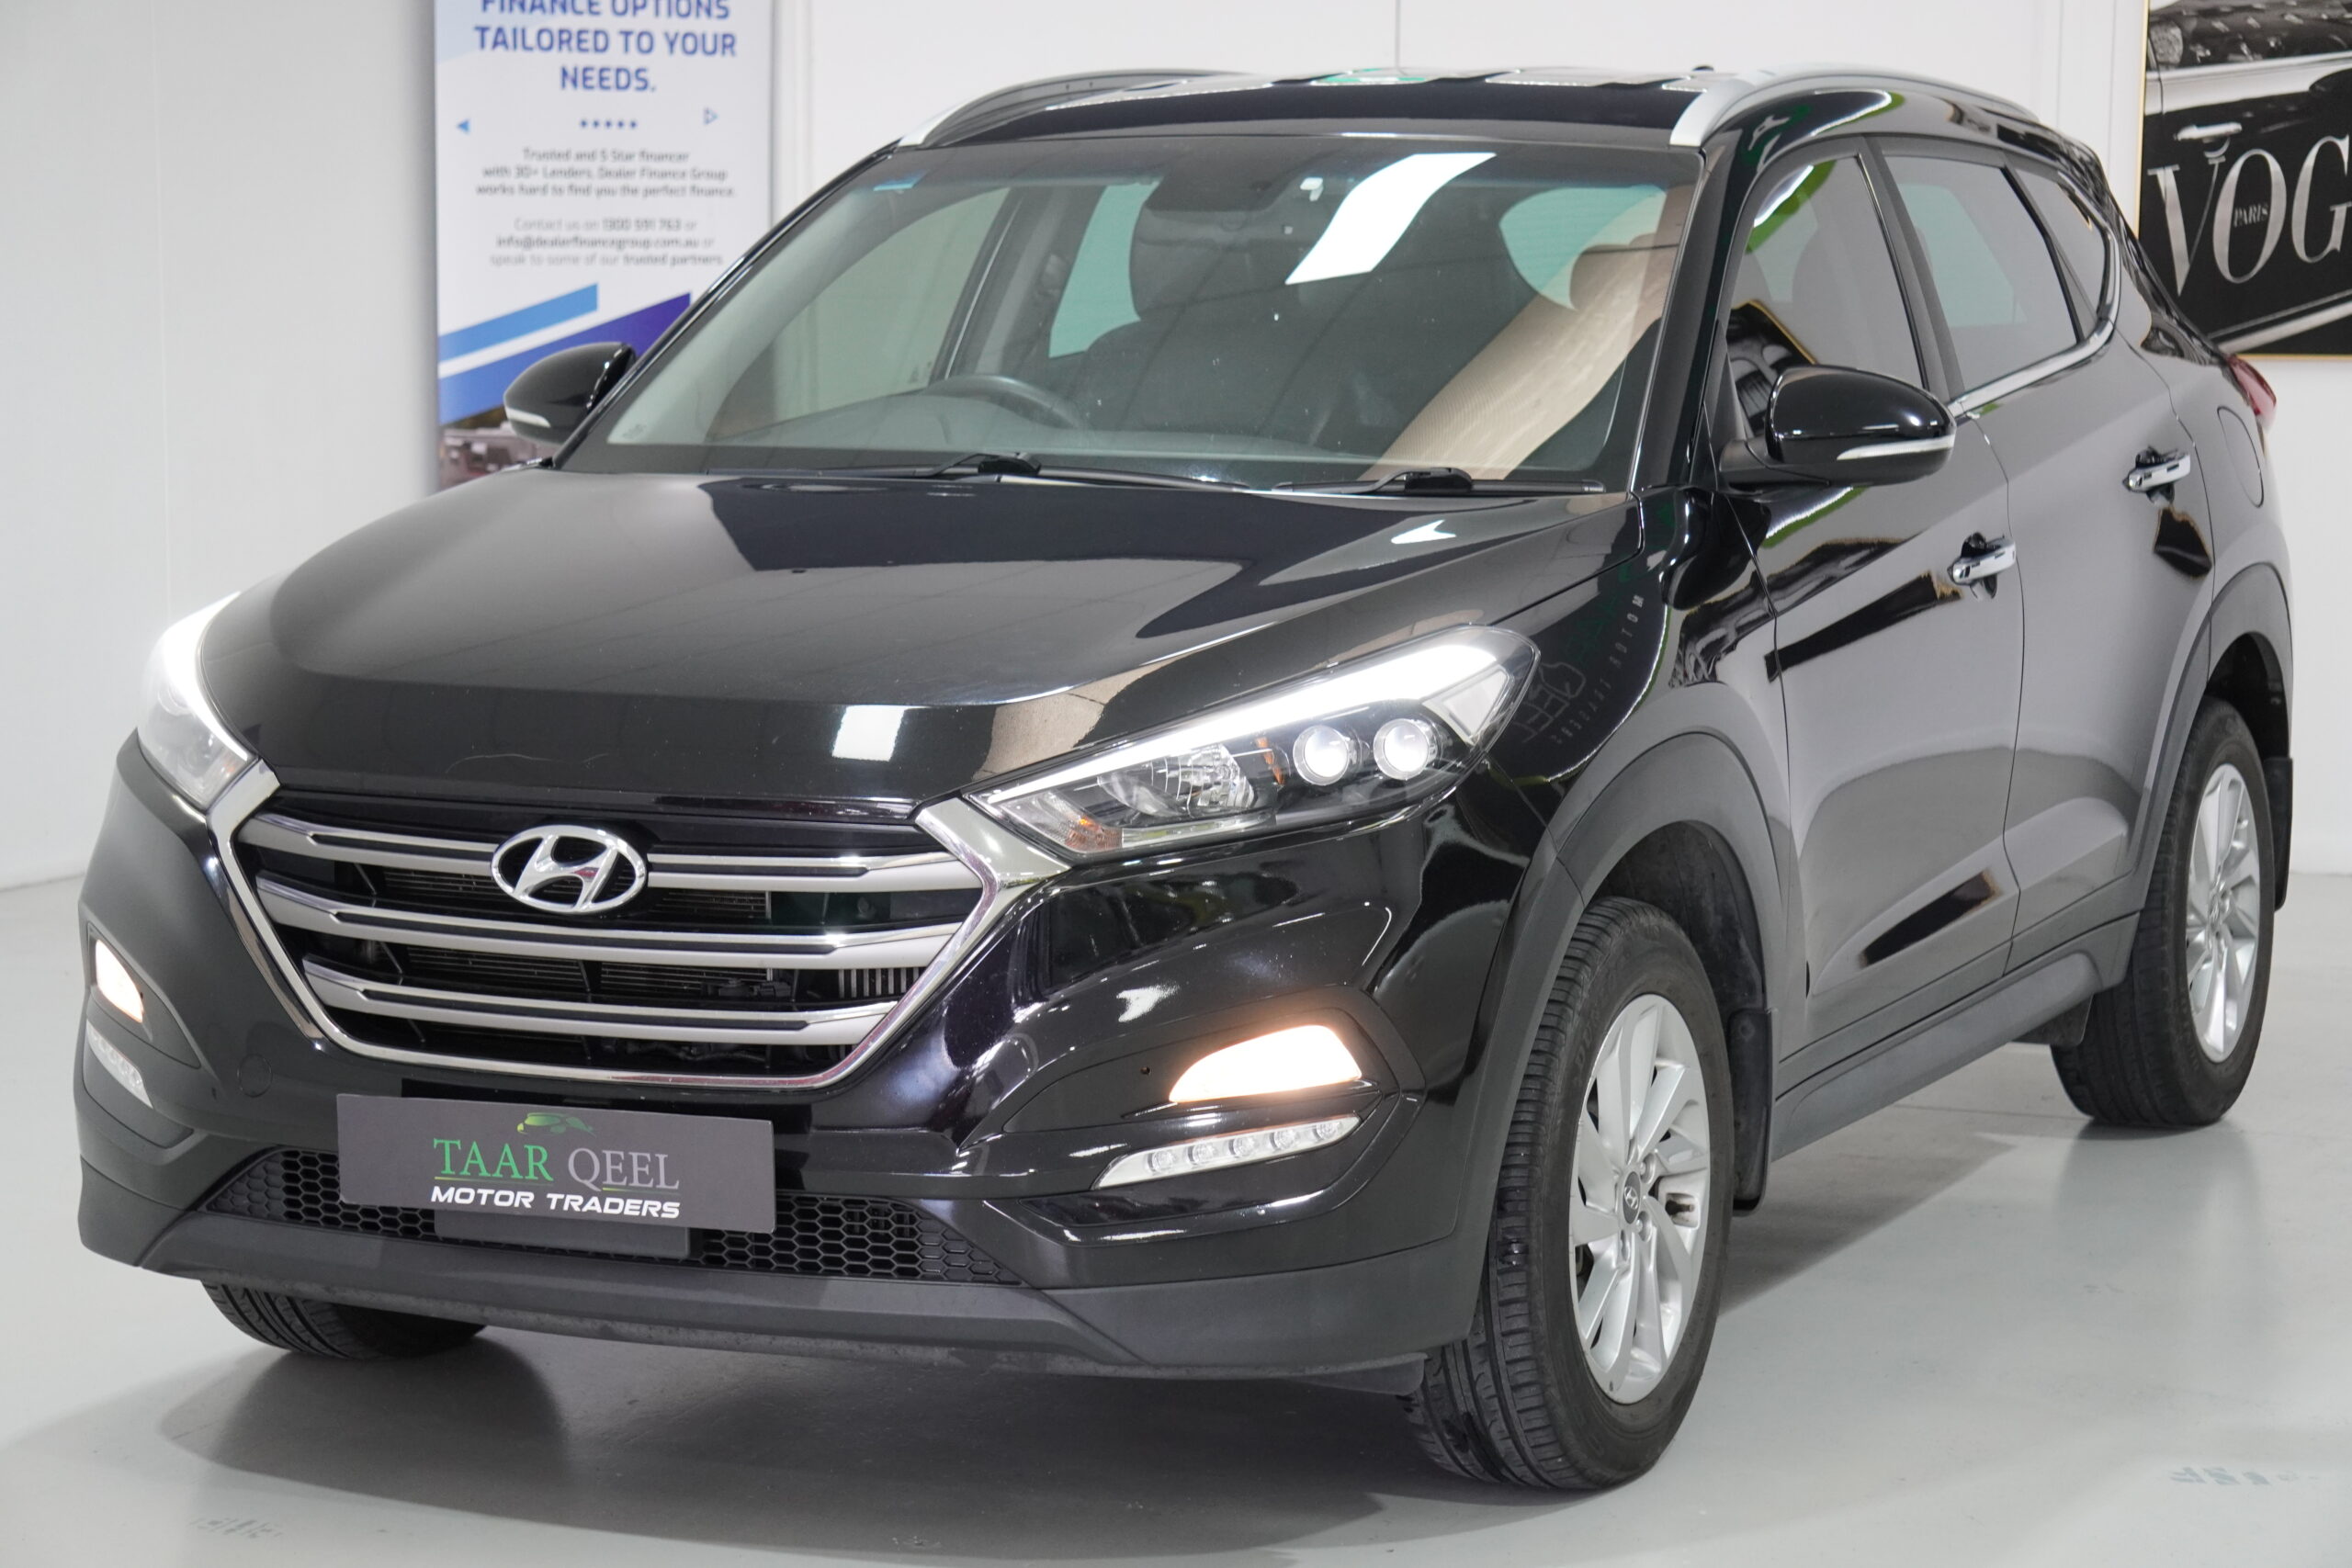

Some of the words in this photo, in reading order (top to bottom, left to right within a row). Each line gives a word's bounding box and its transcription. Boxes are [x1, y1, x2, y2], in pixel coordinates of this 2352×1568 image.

[481, 0, 601, 16] FINANCE
[611, 0, 730, 19] OPTIONS
[474, 26, 610, 53] TAILORED
[618, 30, 655, 54] TO
[663, 31, 738, 57] YOUR
[560, 65, 656, 93] NEEDS.
[523, 147, 572, 162] Trusted
[574, 149, 597, 162] and
[600, 149, 608, 162] 5
[610, 149, 636, 163] Star
[639, 149, 690, 163] financer
[482, 164, 512, 178] with
[514, 165, 539, 179] 30+
[597, 166, 637, 180] Dealer
[639, 166, 686, 180] Finance
[690, 167, 729, 183] Group
[476, 184, 514, 196] works
[518, 184, 549, 197] hard
[551, 185, 565, 197] to
[567, 184, 593, 197] find
[595, 186, 617, 199] you
[619, 185, 639, 197] the
[642, 186, 686, 200] perfect
[514, 217, 562, 231] Contact
[565, 220, 581, 231] us
[582, 220, 600, 231] on
[2233, 202, 2270, 228] PARIS
[622, 254, 669, 266] trusted
[433, 1137, 553, 1181] TAAR
[568, 1147, 680, 1190] QEEL
[431, 1186, 535, 1209] MOTOR
[546, 1193, 681, 1219] TRADERS
